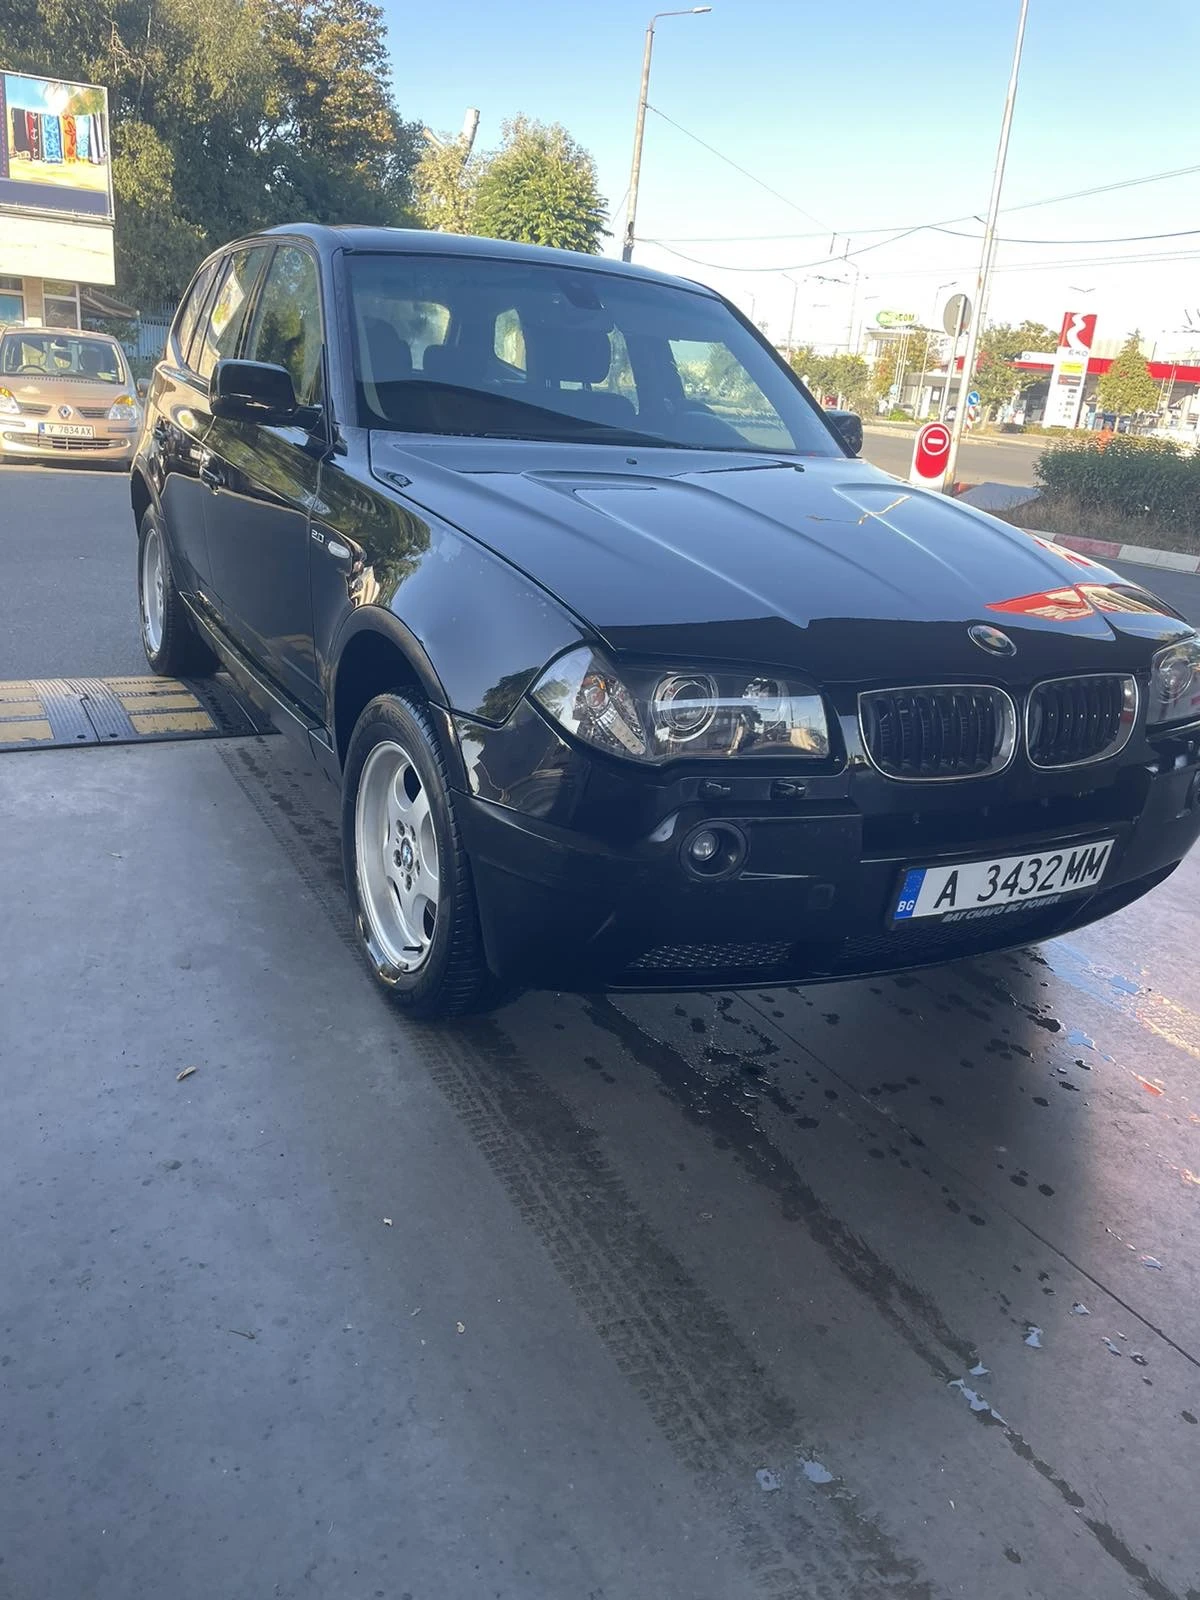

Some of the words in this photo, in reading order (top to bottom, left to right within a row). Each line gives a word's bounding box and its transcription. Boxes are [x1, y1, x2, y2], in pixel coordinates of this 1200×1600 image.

[933, 869, 959, 909] A
[897, 899, 915, 912] BG
[1004, 902, 1023, 914] BG
[1021, 894, 1062, 909] POWER
